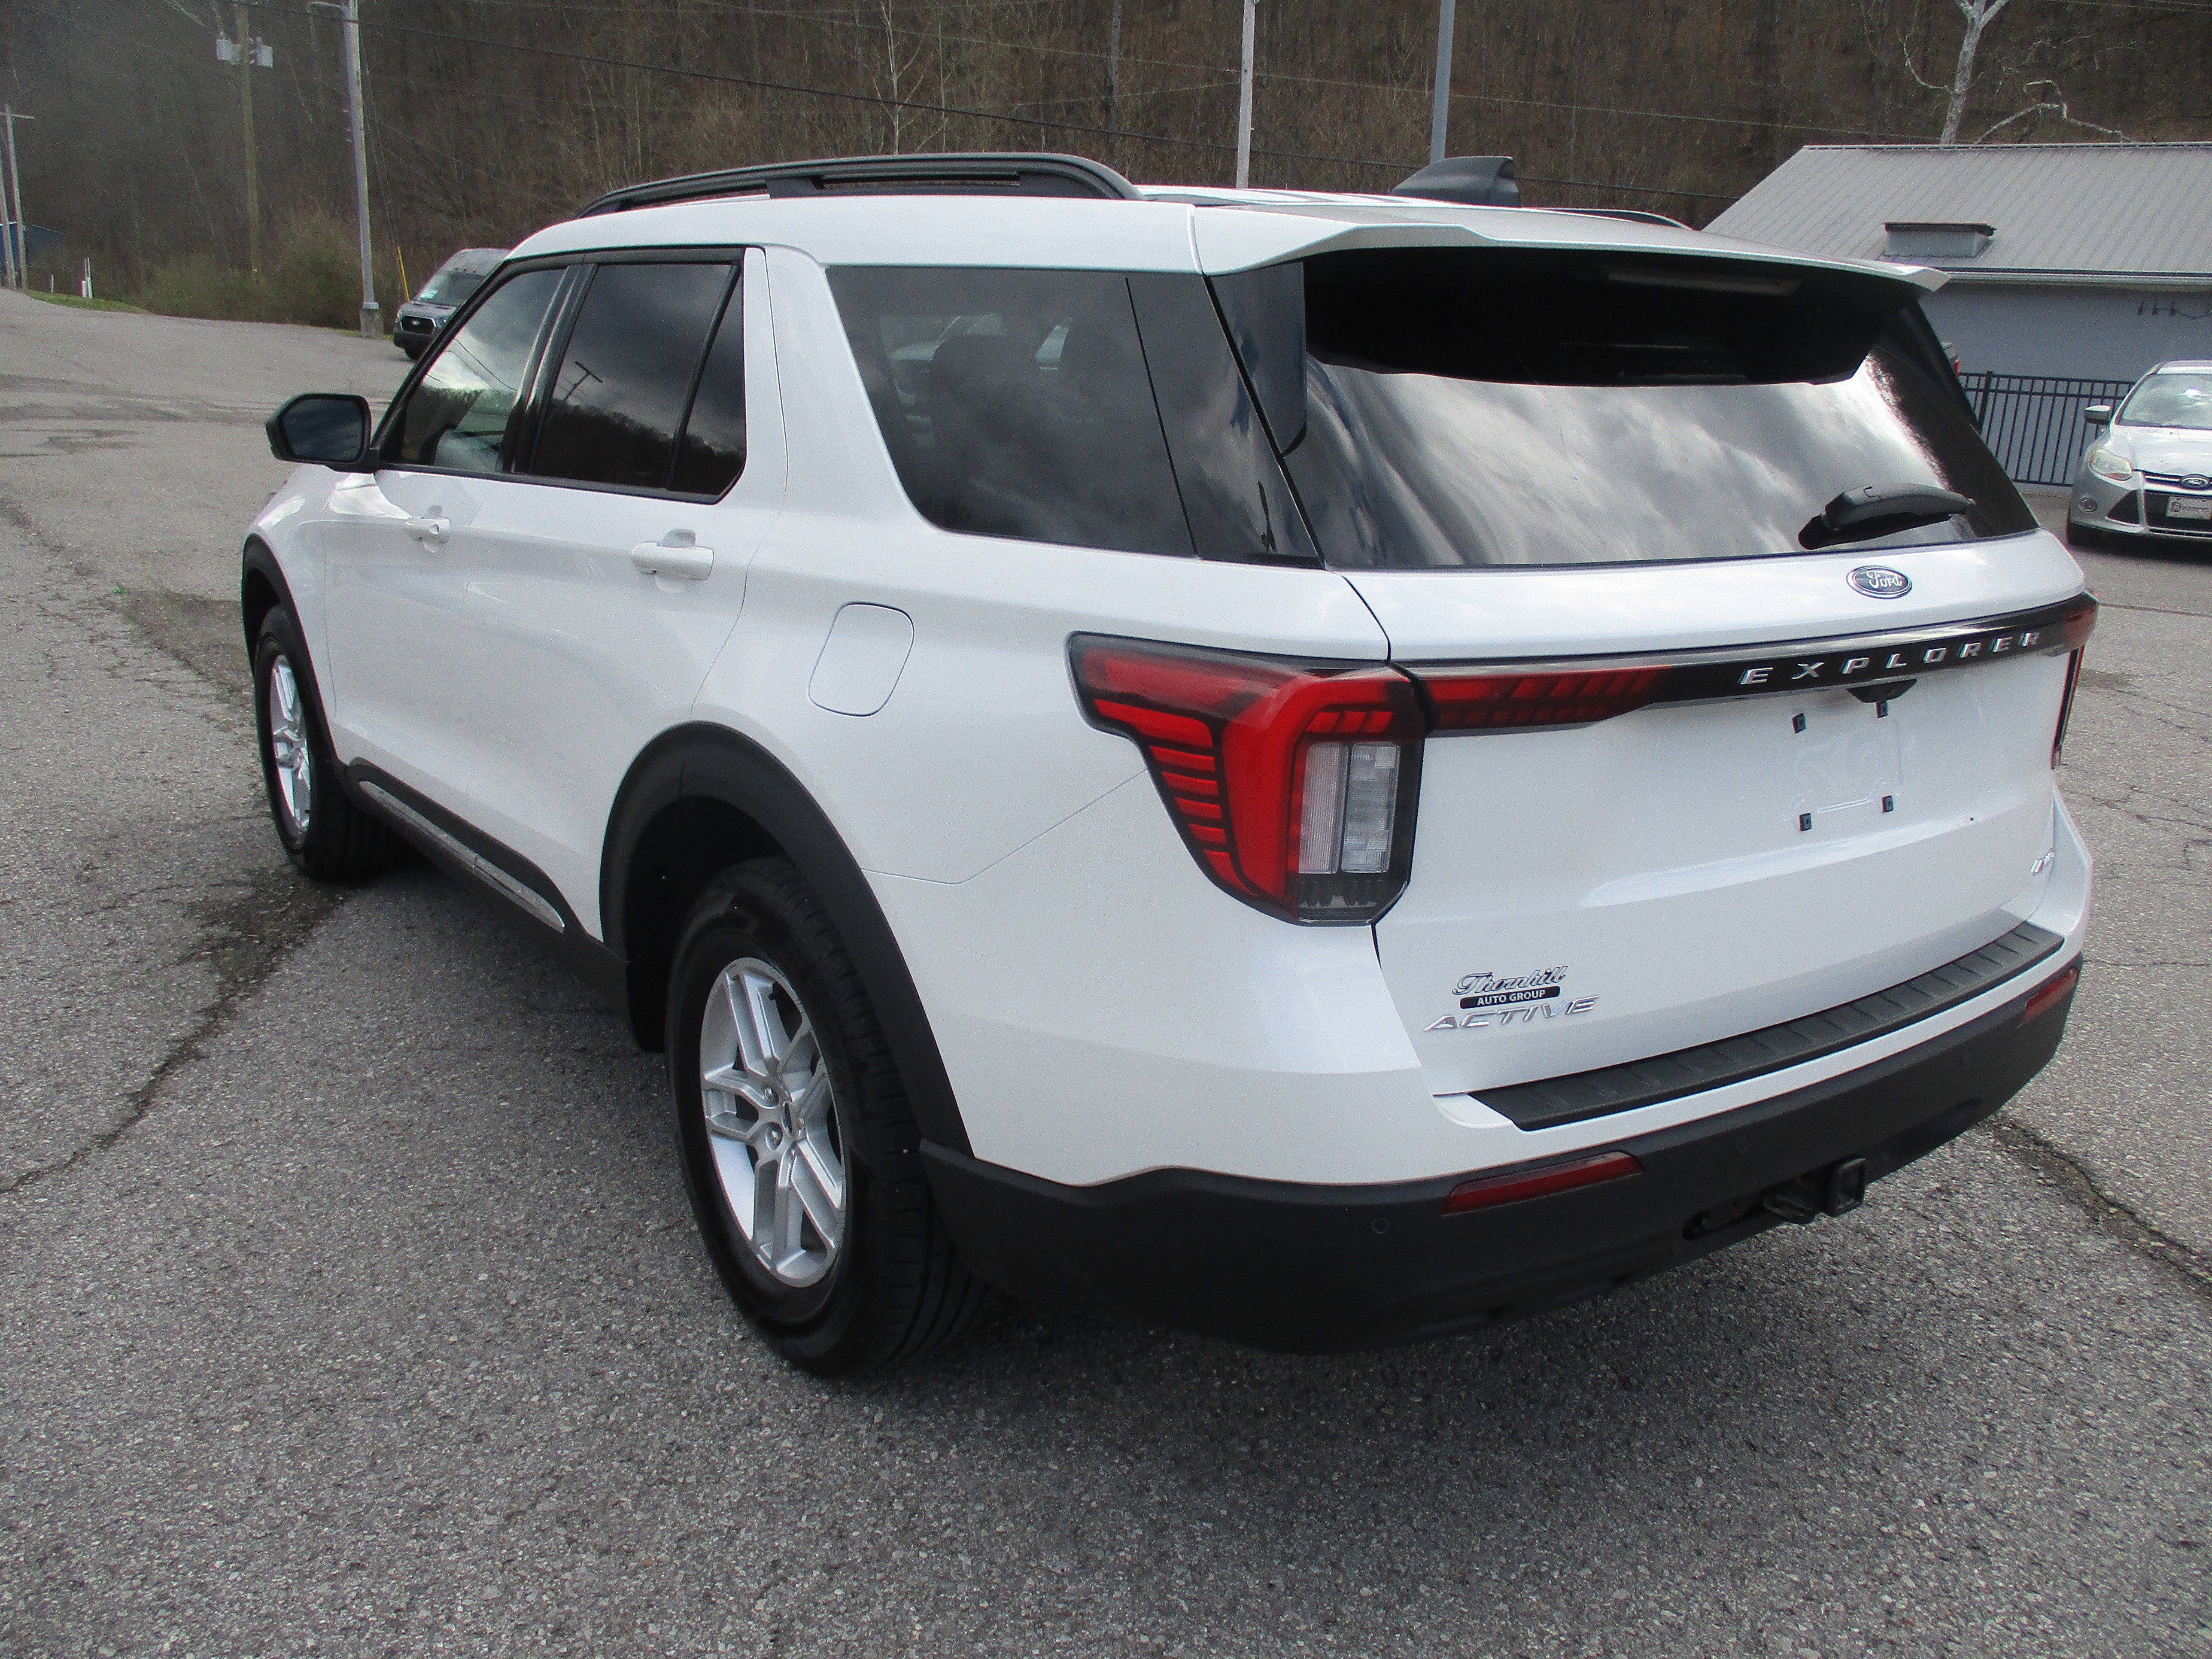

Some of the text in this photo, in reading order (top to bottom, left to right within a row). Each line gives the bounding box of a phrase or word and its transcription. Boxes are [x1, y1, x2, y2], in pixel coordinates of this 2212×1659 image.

[1866, 570, 1902, 589] Ford
[1739, 632, 2040, 685] EXPLORER
[1452, 965, 1568, 995] Thornhill
[1423, 994, 1600, 1031] ACTIVE
[1477, 989, 1546, 1006] AUTO GROUP
